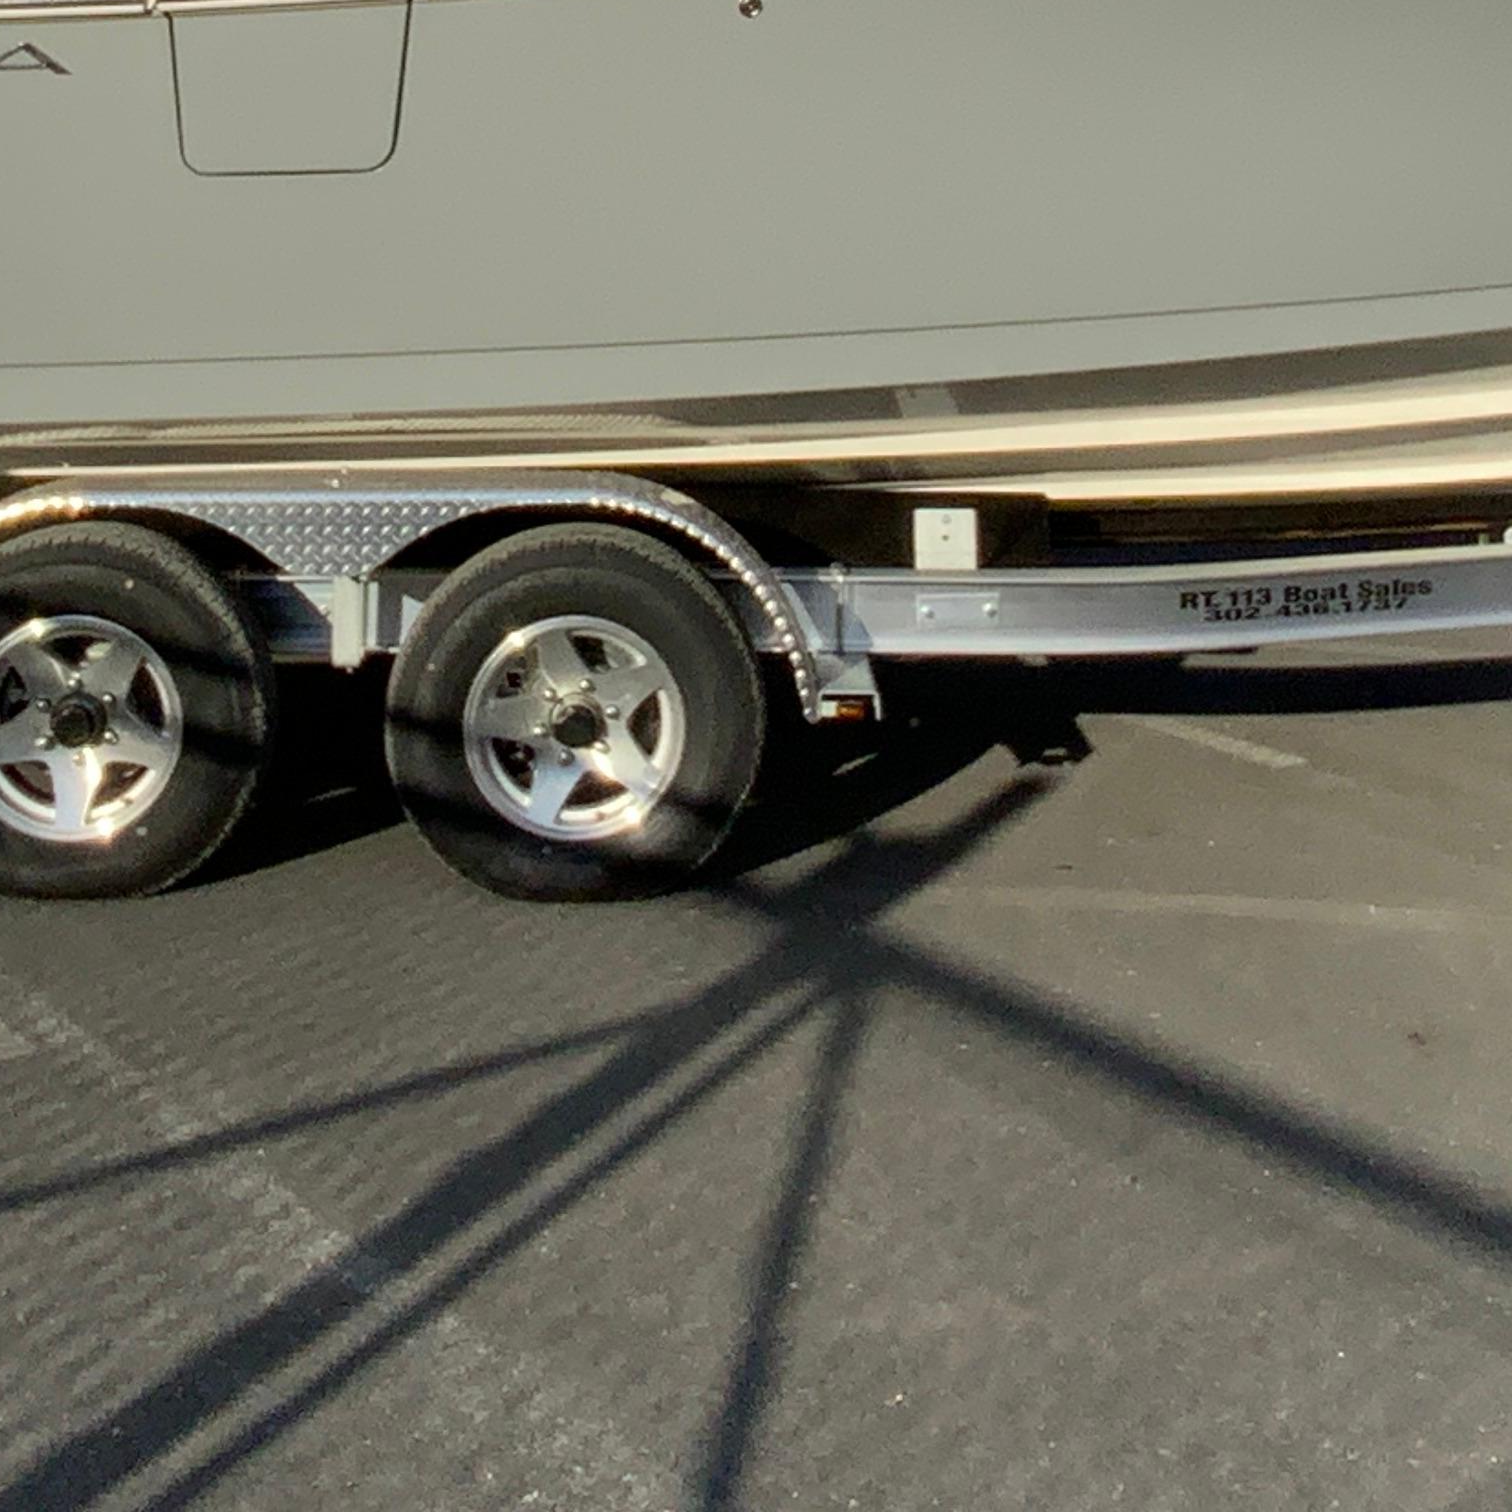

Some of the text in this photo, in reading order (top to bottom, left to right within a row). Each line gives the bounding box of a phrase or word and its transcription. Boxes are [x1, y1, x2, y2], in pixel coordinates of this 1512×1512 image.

[1226, 587, 1271, 606] 113
[1284, 583, 1348, 603] Boat
[1357, 579, 1433, 600] Sales
